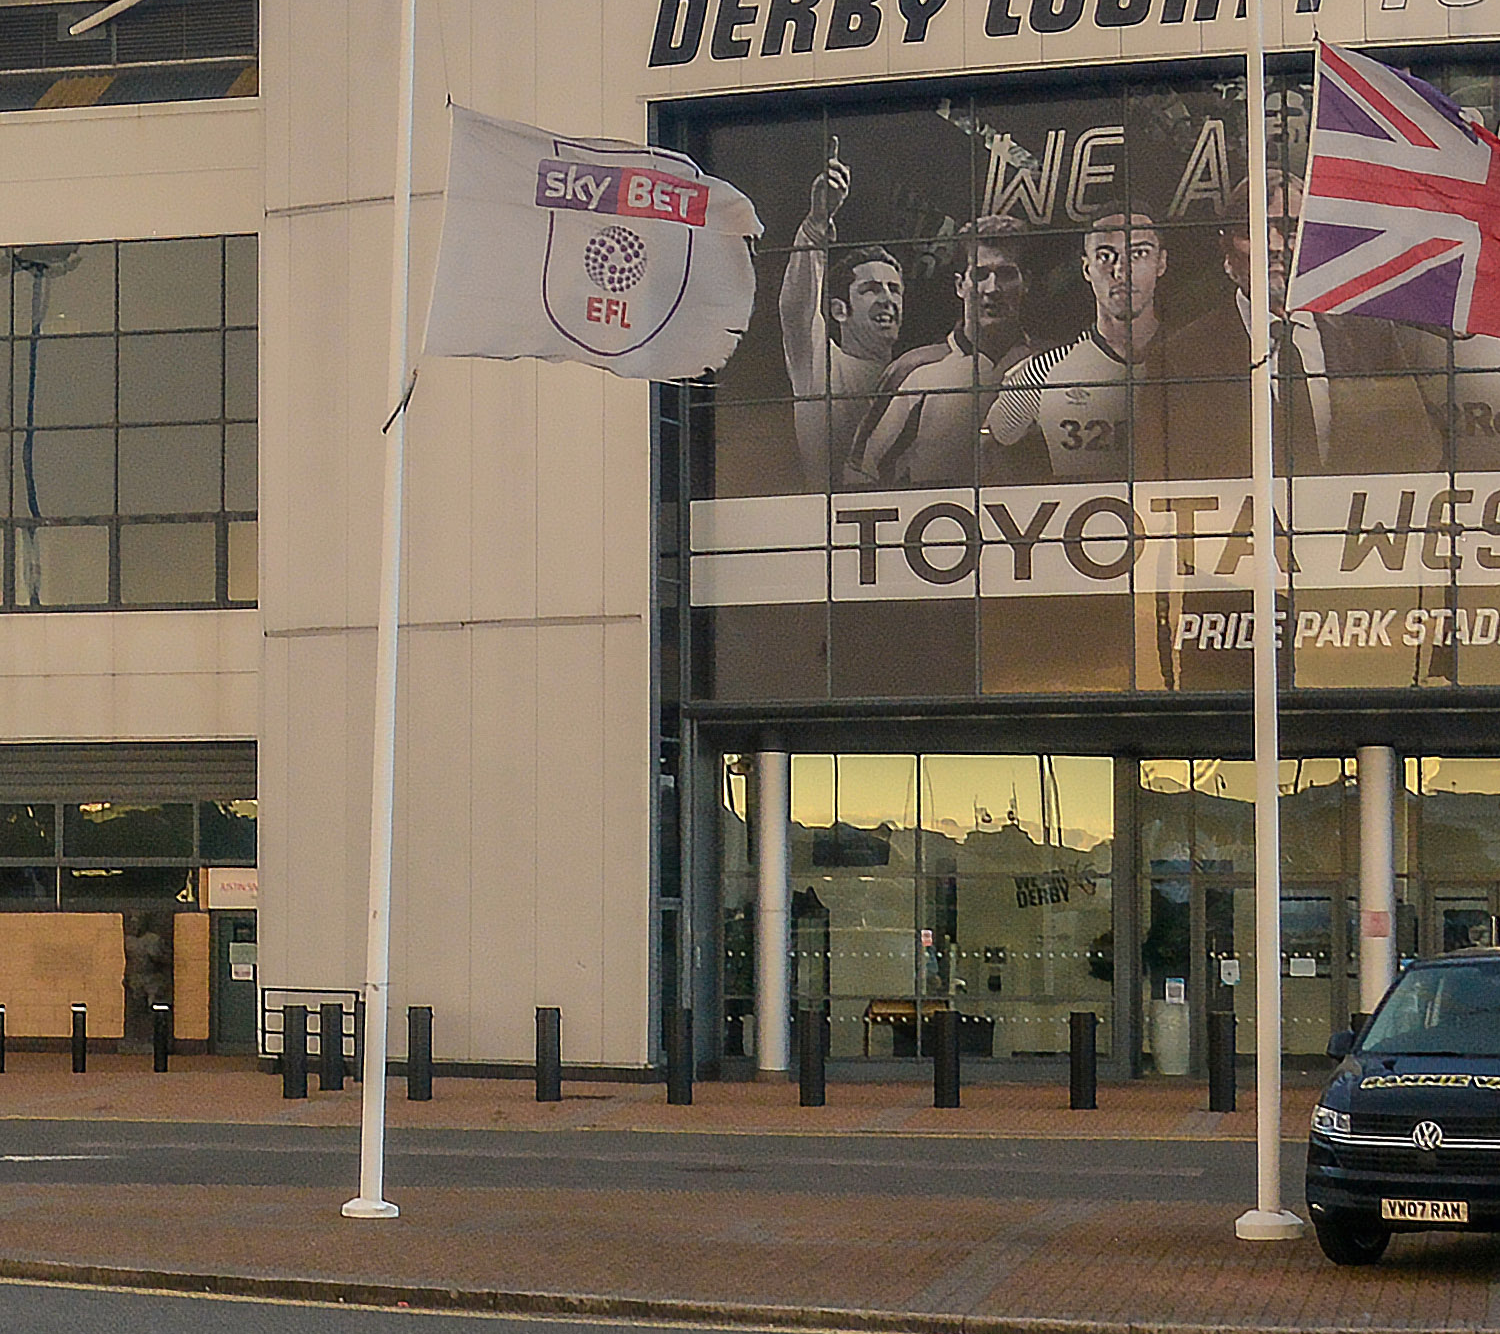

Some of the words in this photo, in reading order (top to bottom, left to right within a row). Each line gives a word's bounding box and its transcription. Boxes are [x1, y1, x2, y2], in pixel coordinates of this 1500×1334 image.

[544, 165, 612, 210] sky
[626, 174, 700, 219] BET
[981, 125, 1125, 224] WE
[585, 295, 632, 329] EFL
[834, 494, 1302, 585] TOYOTA
[1294, 608, 1398, 650] PARK
